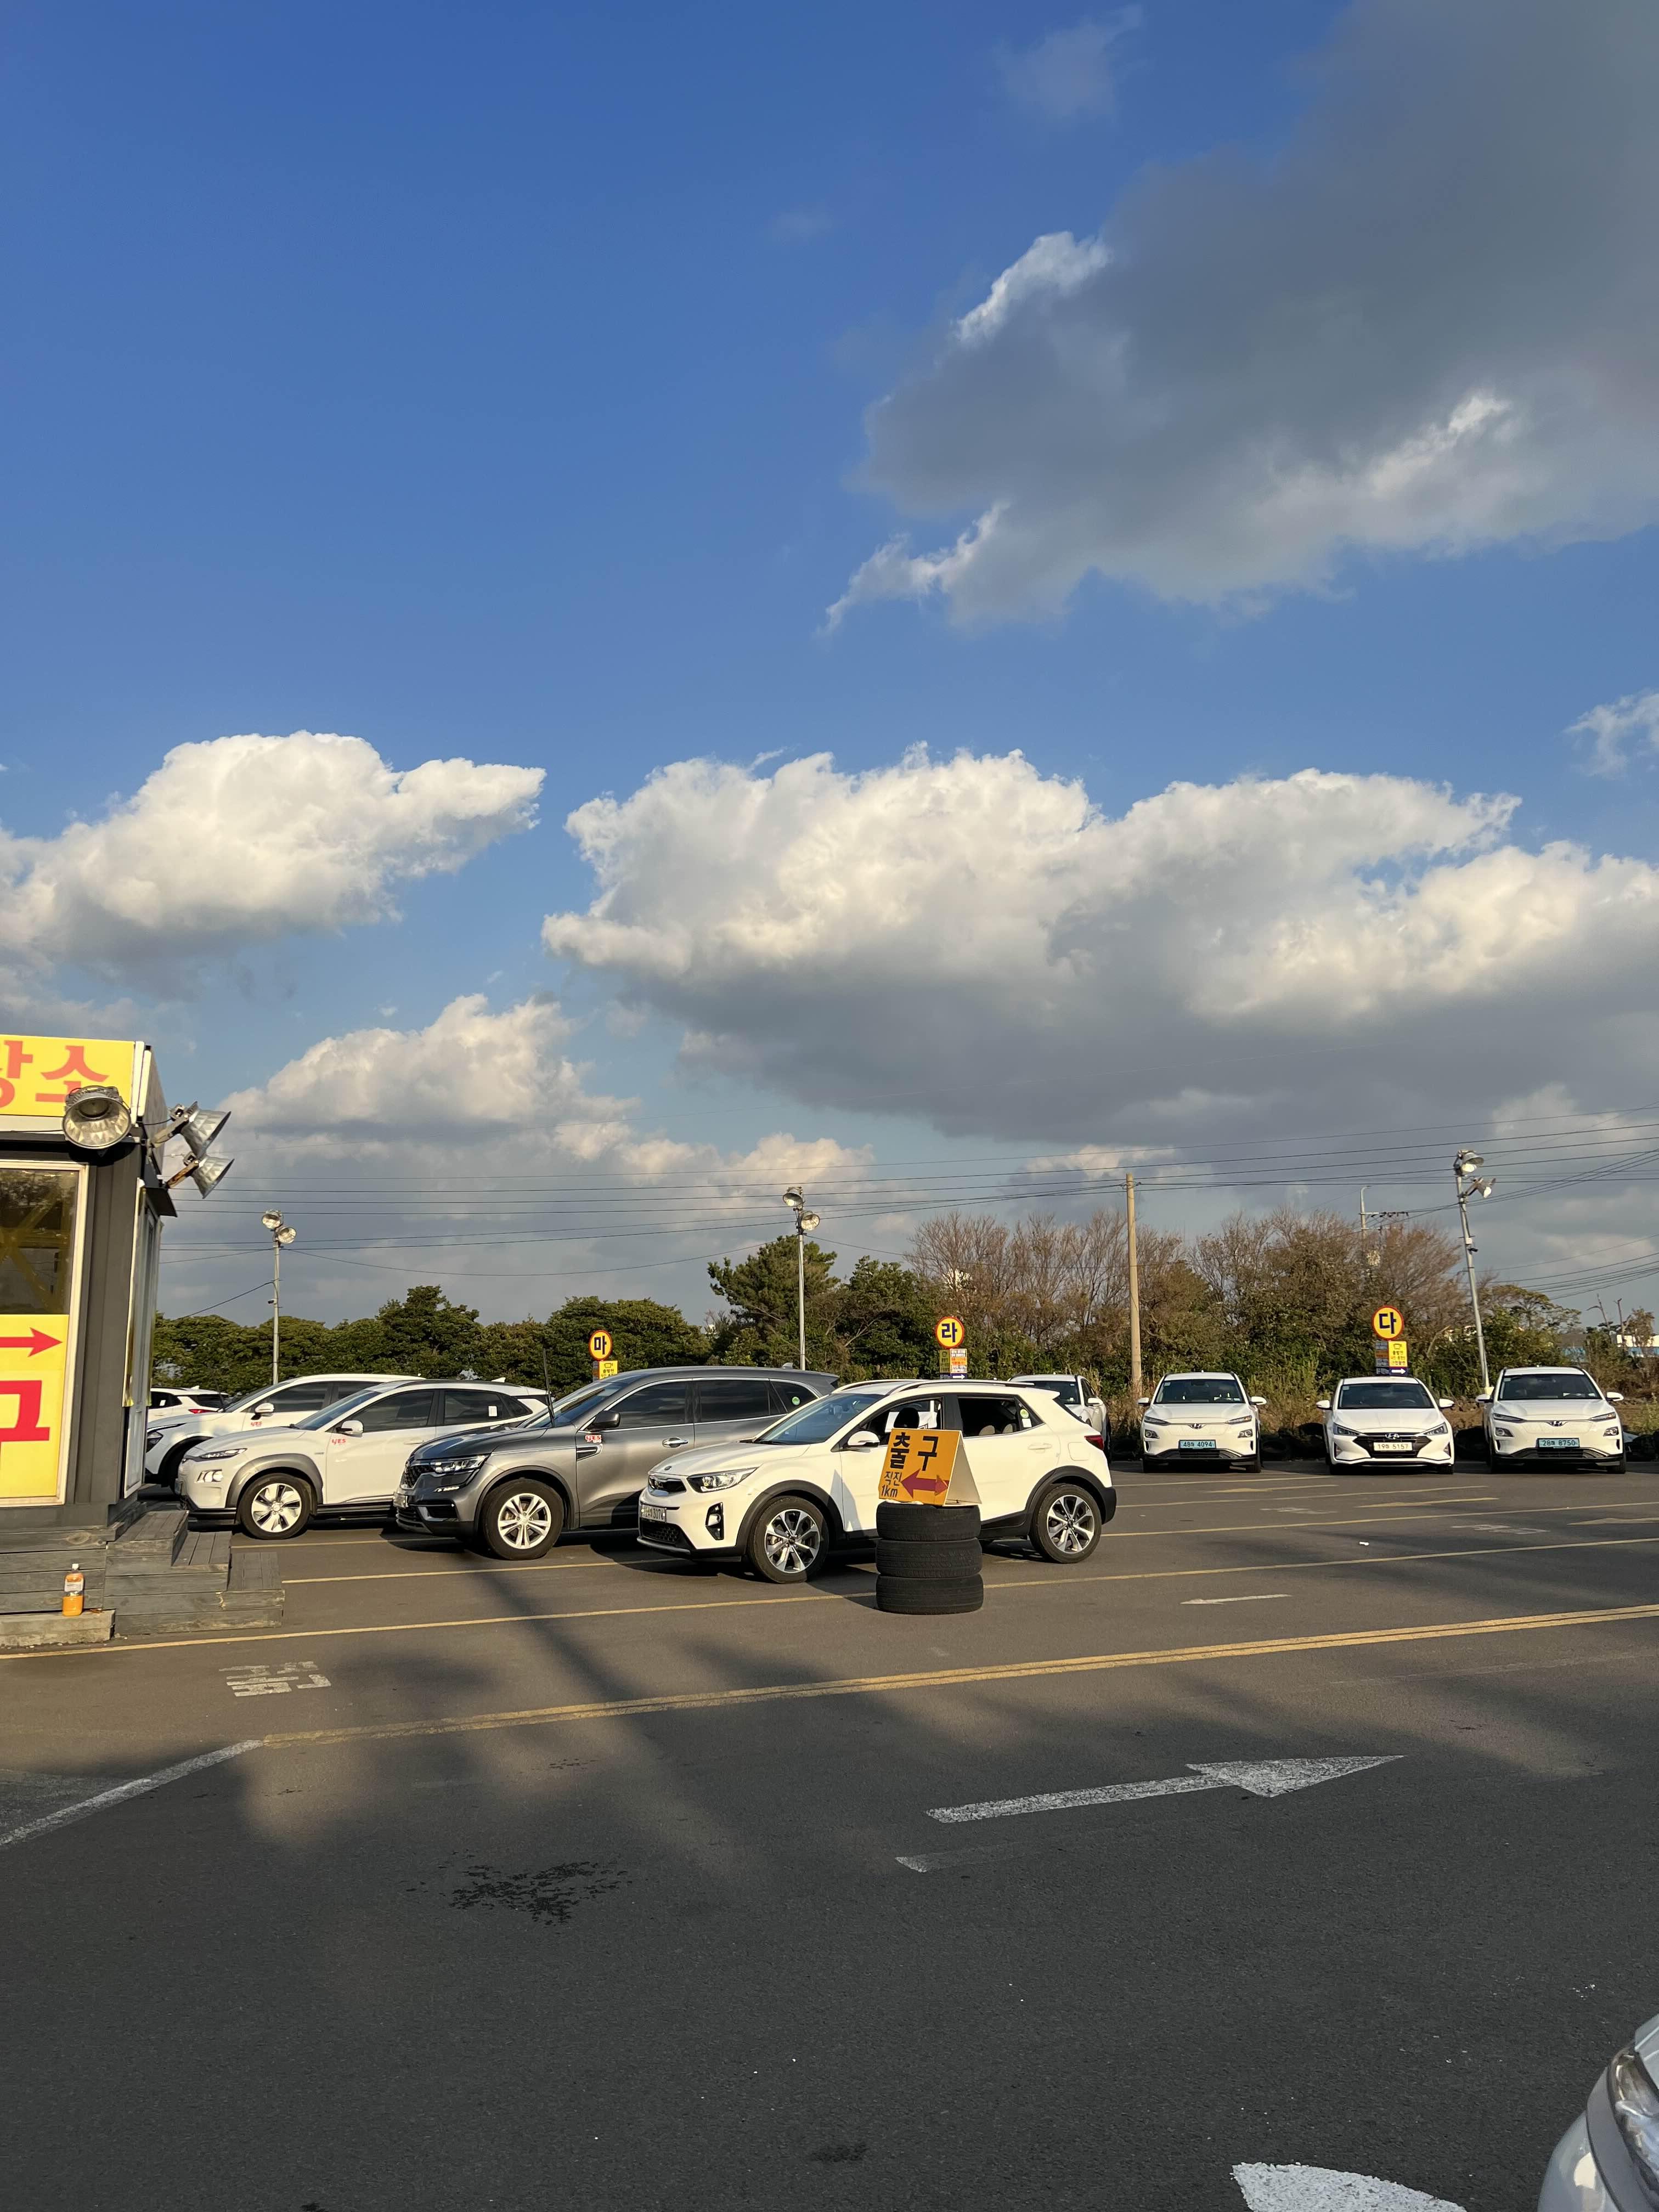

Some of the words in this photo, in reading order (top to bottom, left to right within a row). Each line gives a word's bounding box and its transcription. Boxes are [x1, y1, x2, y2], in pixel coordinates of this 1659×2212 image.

[941, 1322, 958, 1343] 라
[1379, 1312, 1397, 1334] 다
[594, 1335, 607, 1355] 마
[890, 1432, 939, 1471] 출구
[884, 1471, 902, 1486] 직진
[881, 1485, 898, 1498] 1km
